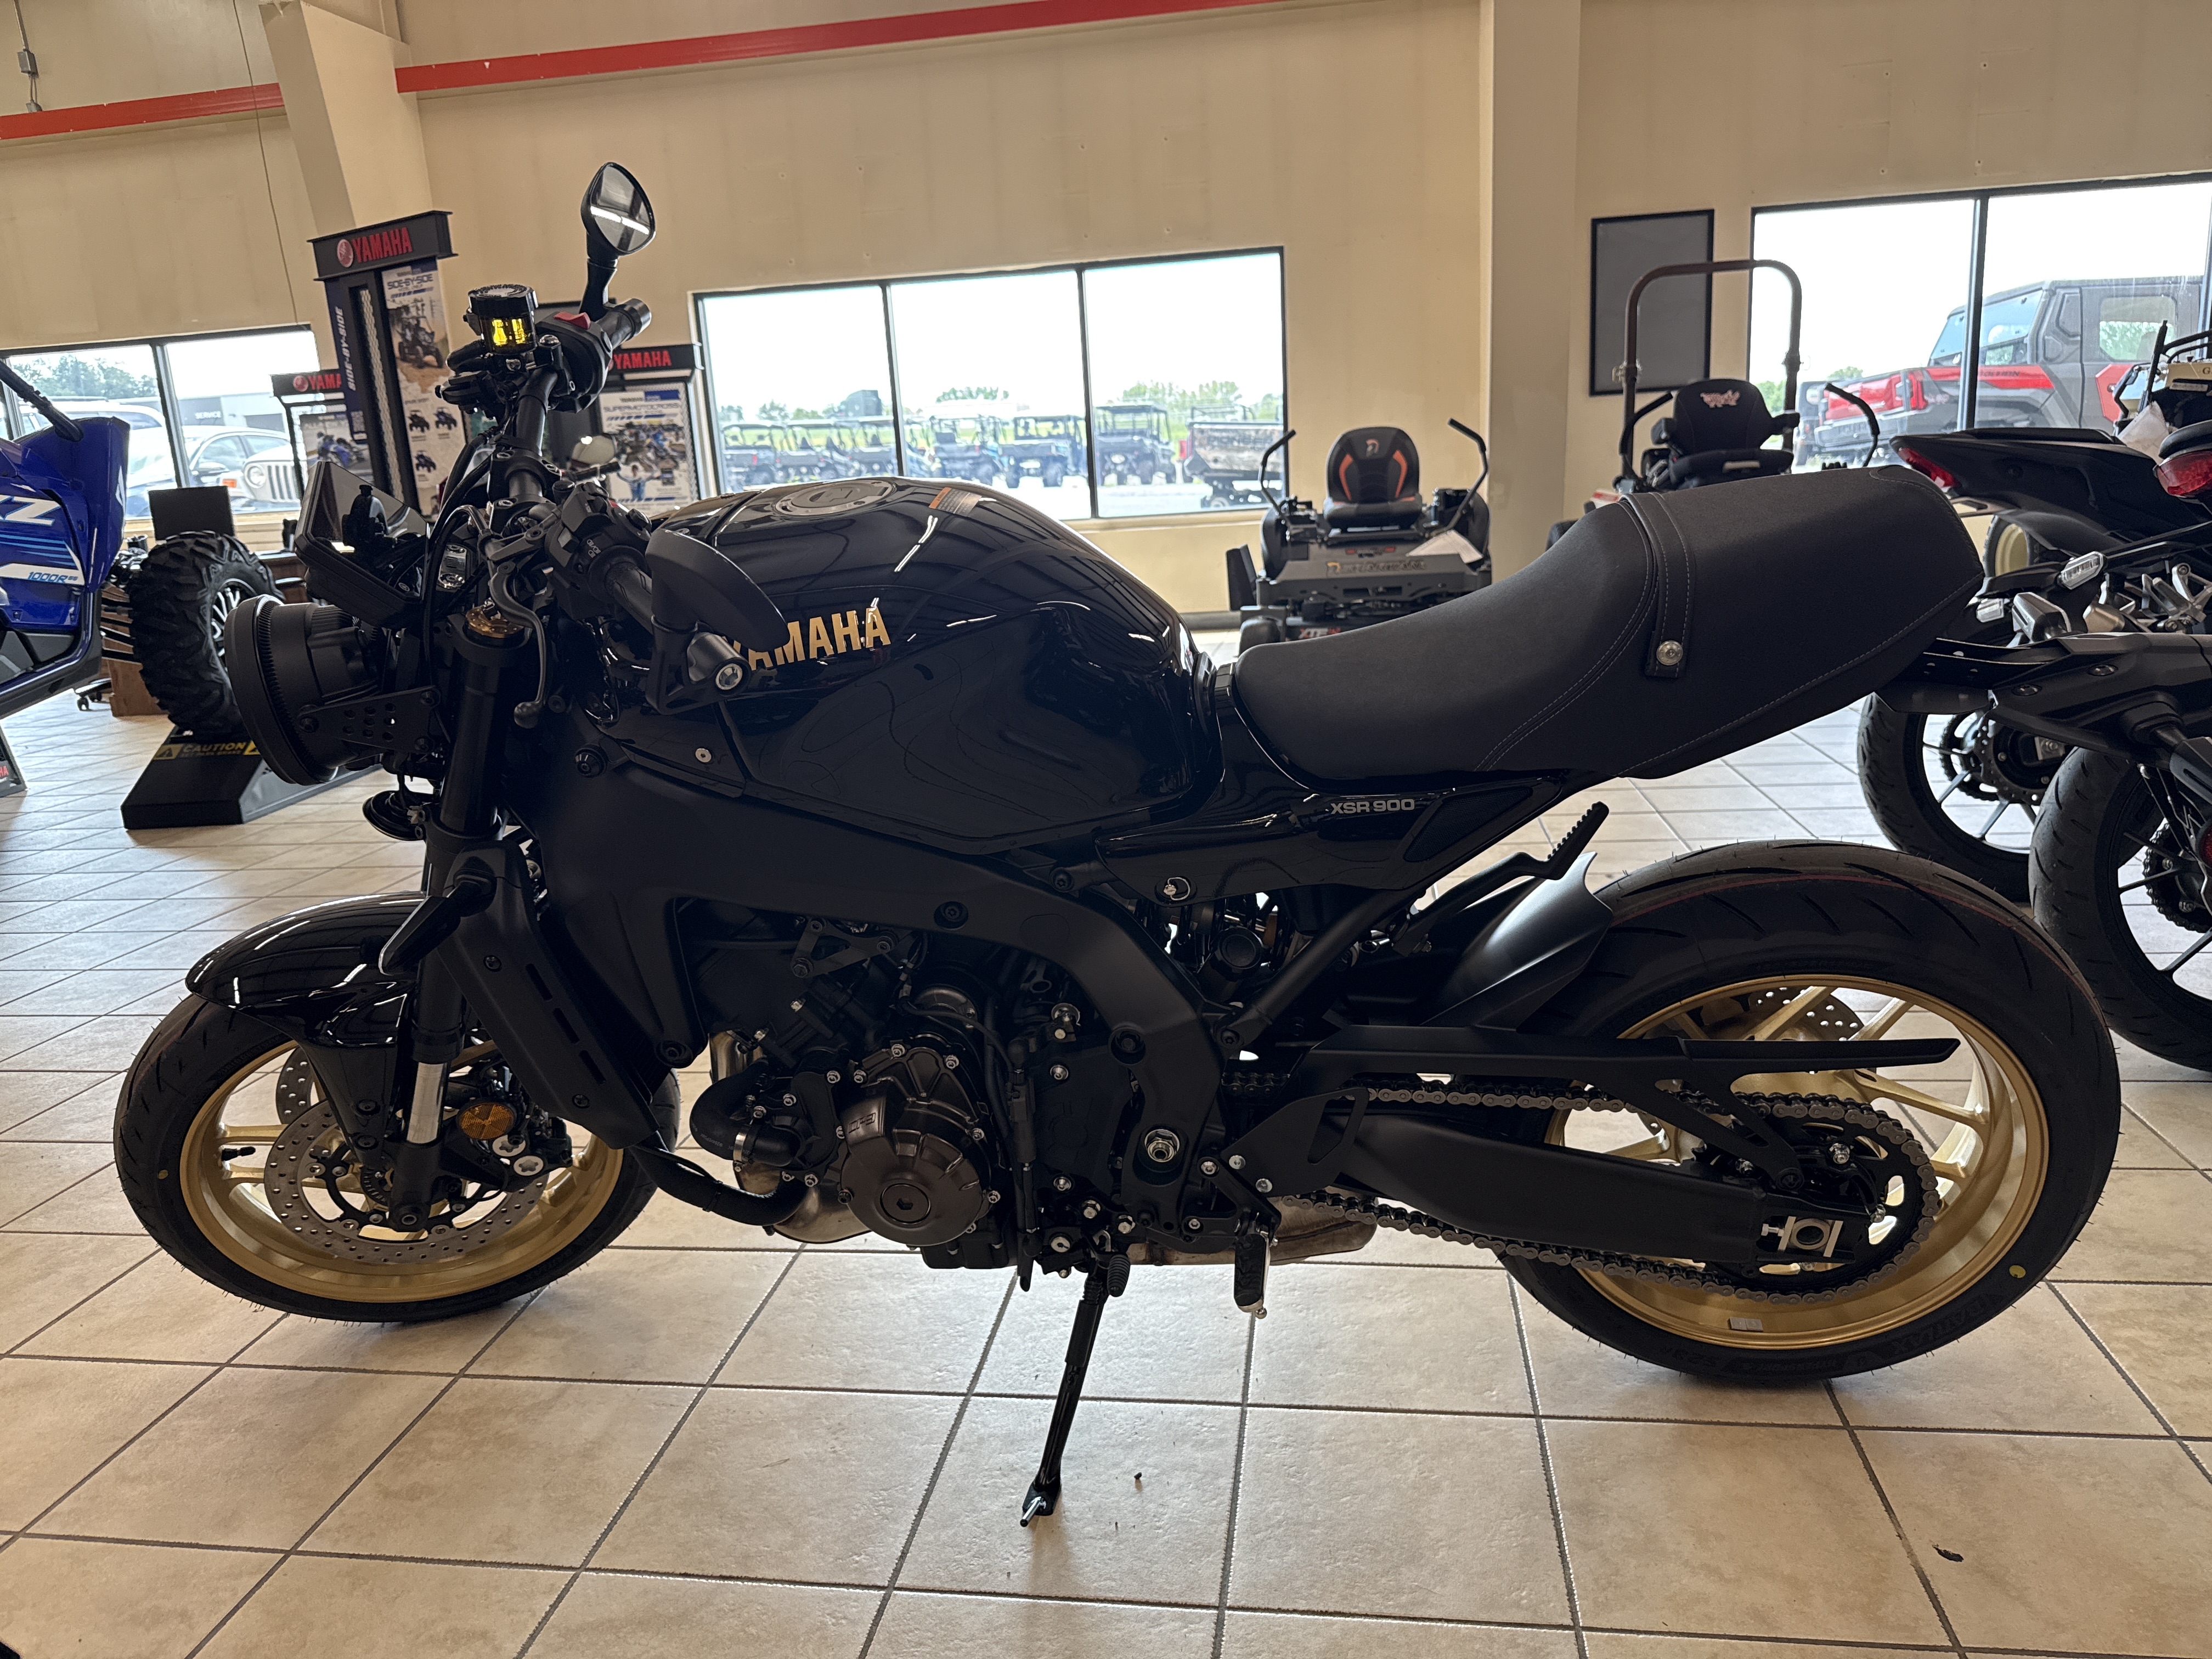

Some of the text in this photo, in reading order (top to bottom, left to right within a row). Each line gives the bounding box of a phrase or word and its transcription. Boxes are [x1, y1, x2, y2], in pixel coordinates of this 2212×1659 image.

[352, 227, 412, 263] YAMAHA
[335, 306, 356, 391] SIDE-BY-SIDE
[613, 350, 672, 370] YAMAHA
[195, 410, 222, 419] SERVICE
[27, 571, 69, 583] 1000R
[722, 607, 891, 671] AMAHA
[183, 742, 246, 753] CAUTION
[1330, 799, 1415, 815] XSR 900
